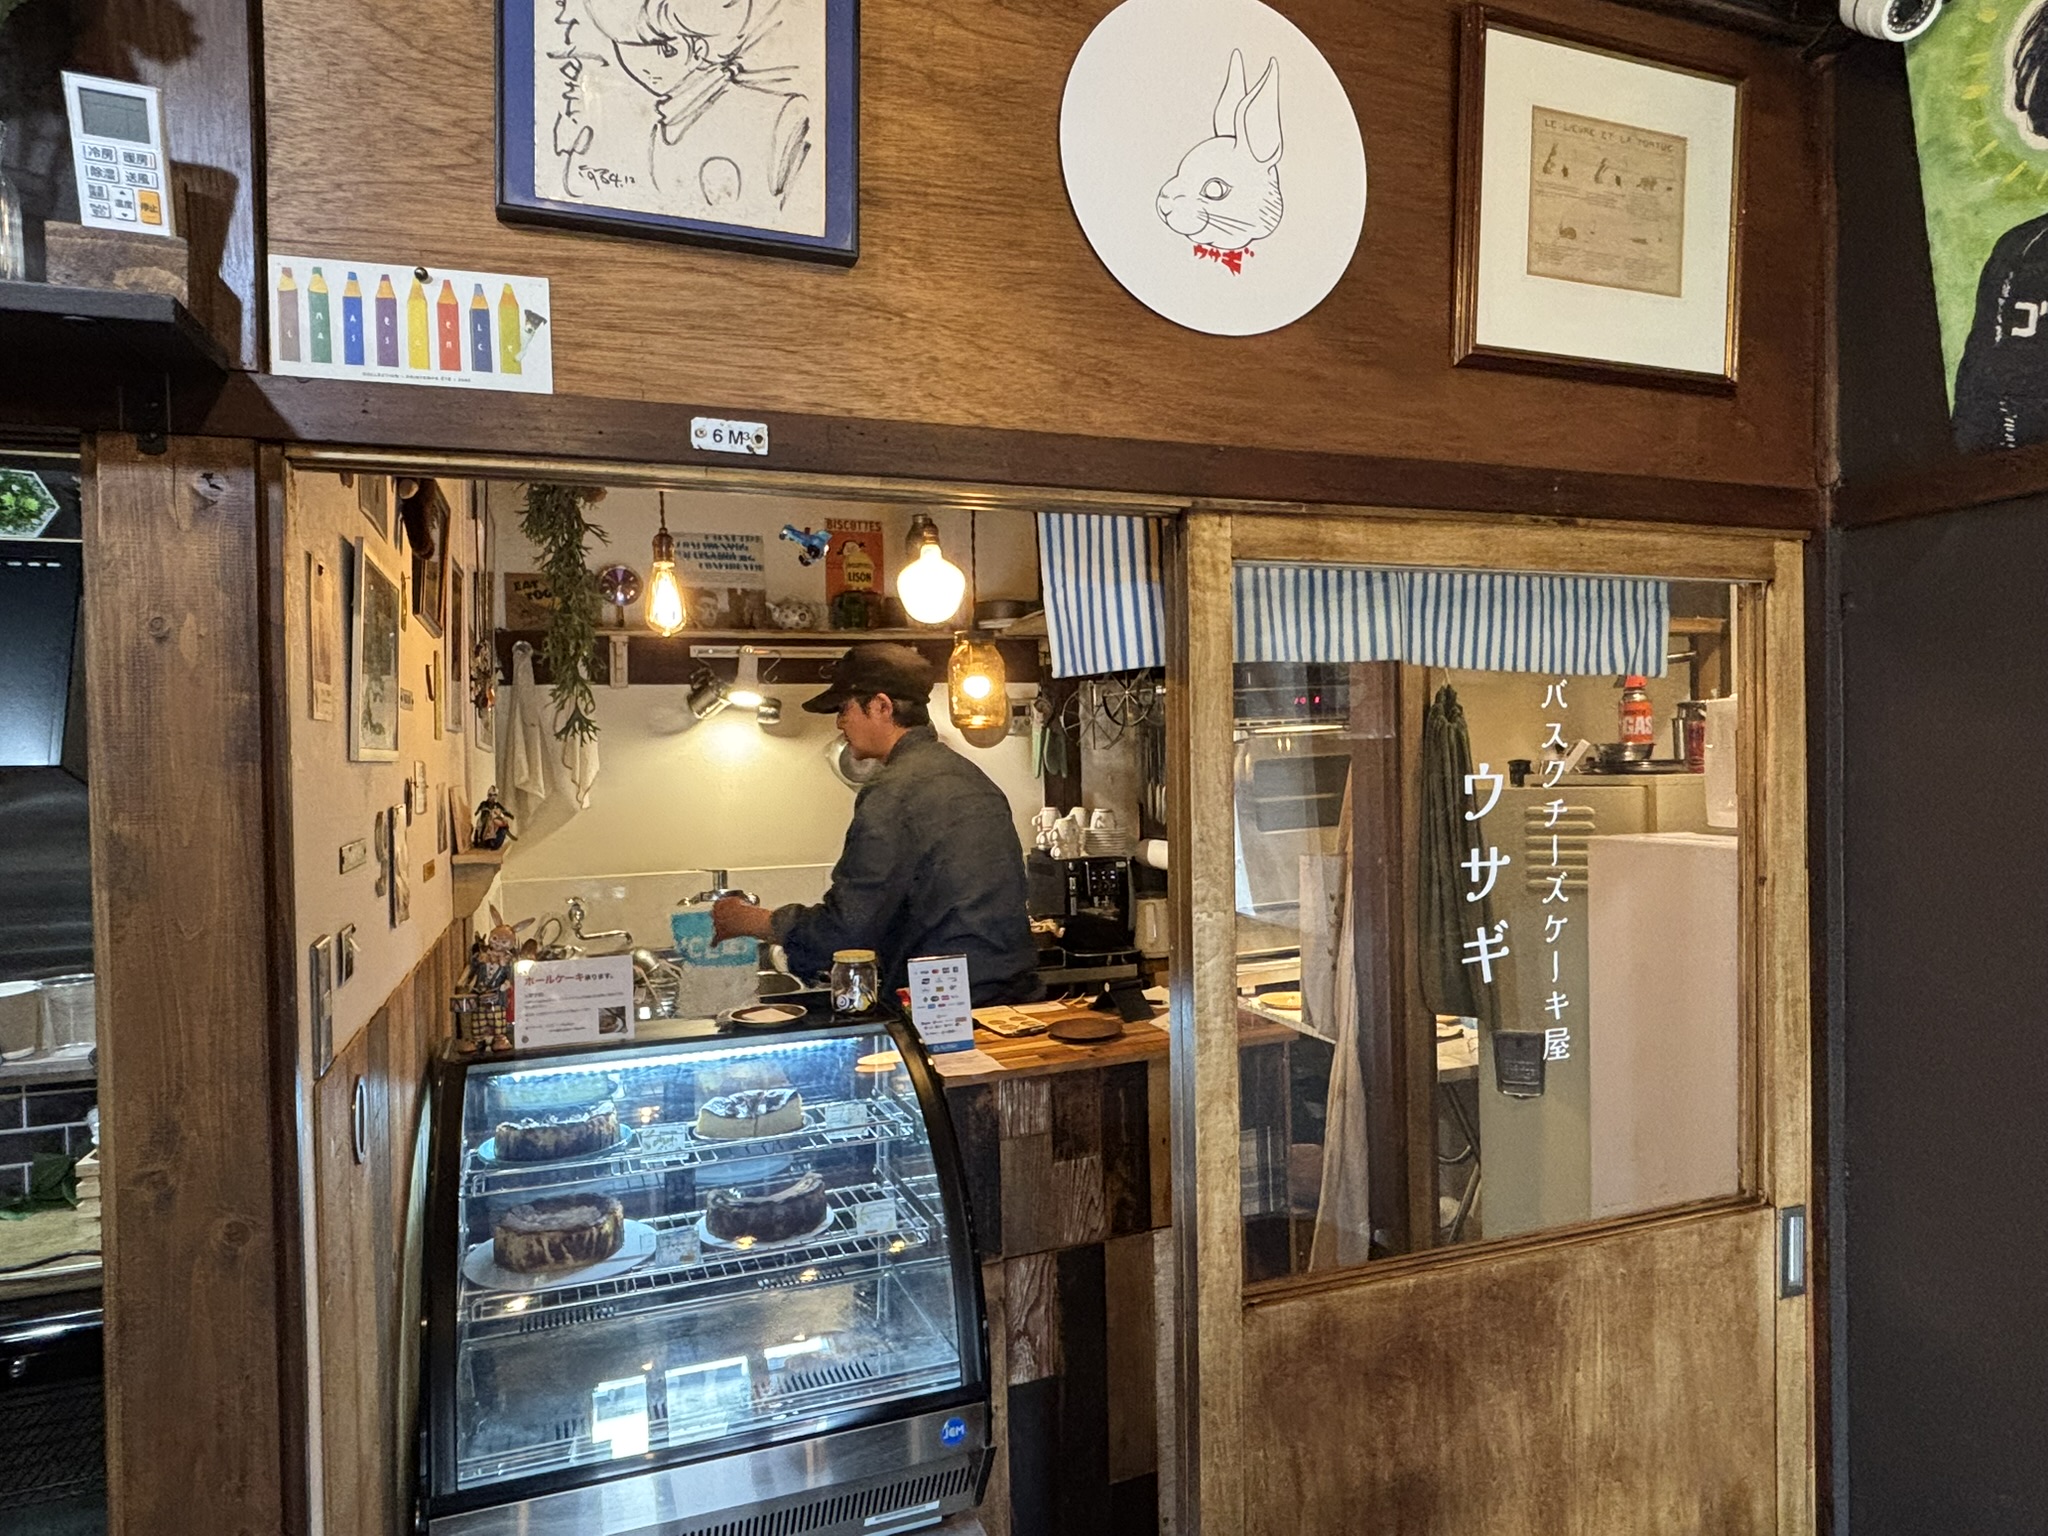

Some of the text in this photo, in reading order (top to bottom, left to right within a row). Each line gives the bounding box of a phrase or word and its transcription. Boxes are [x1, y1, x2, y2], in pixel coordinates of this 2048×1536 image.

[713, 429, 723, 443] 6
[826, 520, 882, 532] BISCOTTES
[848, 572, 872, 582] LISON
[513, 580, 539, 591] EAT
[1623, 716, 1652, 735] GAS
[1460, 763, 1511, 984] ウサギ
[1541, 679, 1570, 1061] バスクチーズケーキ屋
